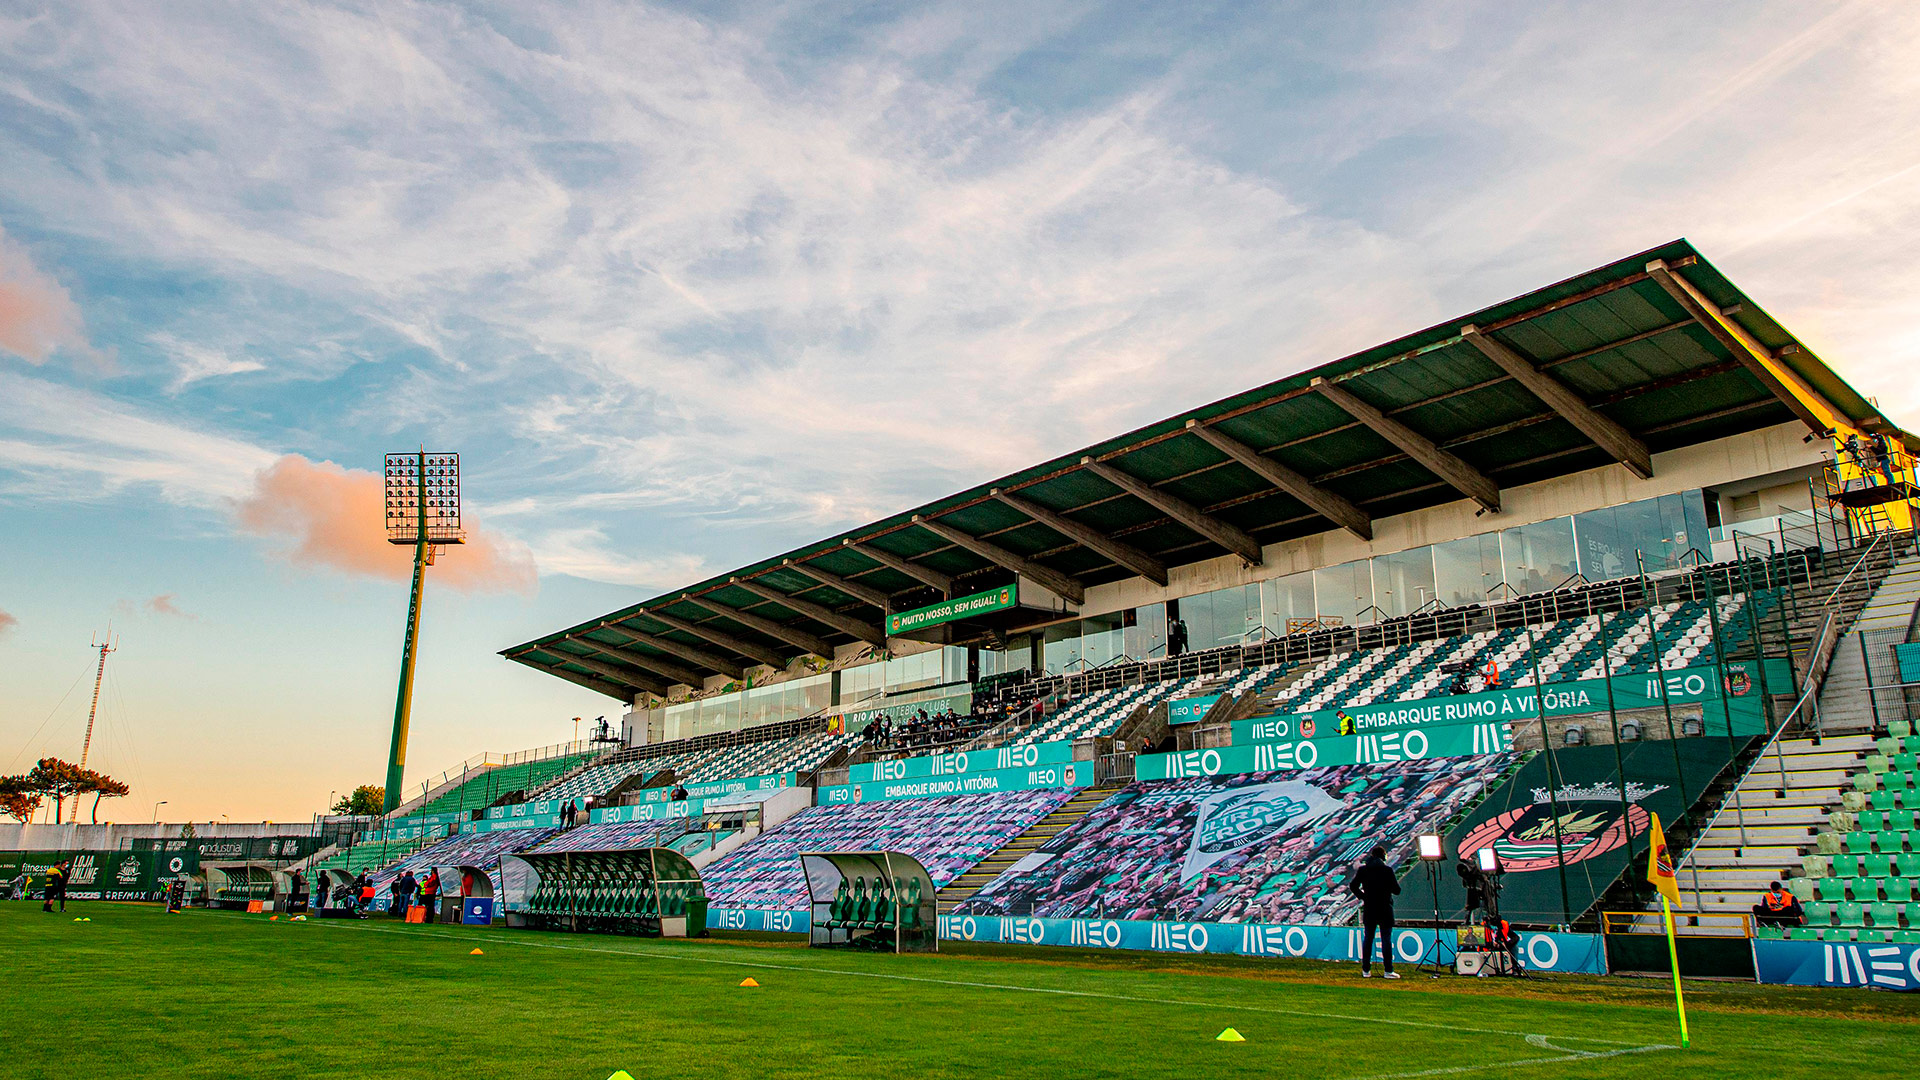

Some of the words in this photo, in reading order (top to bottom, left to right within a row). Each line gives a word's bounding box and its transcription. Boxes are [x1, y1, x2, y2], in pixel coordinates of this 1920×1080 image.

[901, 612, 925, 626] MUITO
[925, 606, 953, 621] NOSSO,
[954, 602, 969, 614] SEM
[970, 594, 997, 609] IGUAL!
[852, 711, 867, 723] RIO
[923, 698, 951, 713] CLUBE
[1357, 705, 1442, 730] EMBARQUE
[1445, 699, 1497, 720] RUMO
[1501, 693, 1514, 714] À
[1252, 720, 1289, 740] MEO
[997, 743, 1039, 769] MEO
[1254, 740, 1318, 772] MEO
[1355, 729, 1429, 764] MEO
[873, 759, 906, 782] MEO
[931, 752, 969, 776] MEO
[1165, 749, 1222, 779] MEO
[725, 780, 747, 793] VITÓRIA
[759, 777, 776, 789] MEO
[885, 782, 929, 798] EMBARQUE
[929, 780, 954, 795] RUMO
[955, 776, 963, 792] À
[963, 773, 999, 791] VITÓRIA
[1028, 768, 1056, 786] MEO
[645, 790, 659, 802] MEO
[828, 788, 849, 802] MEO
[490, 806, 505, 819] MEO
[511, 803, 527, 817] MEO
[533, 801, 550, 815] MEO
[601, 807, 621, 823] MEO
[632, 803, 654, 821] MEO
[665, 800, 689, 818] MEO
[73, 854, 95, 868] LOJA
[69, 866, 100, 880] ONLINE
[111, 891, 147, 900] RE/MAX
[719, 909, 746, 929] MEO
[763, 910, 793, 931] MEO
[937, 916, 977, 941] MEO
[1000, 917, 1045, 944] MEO
[1070, 919, 1122, 947] MEO
[1151, 922, 1209, 952] MEO
[1242, 925, 1309, 957] MEO
